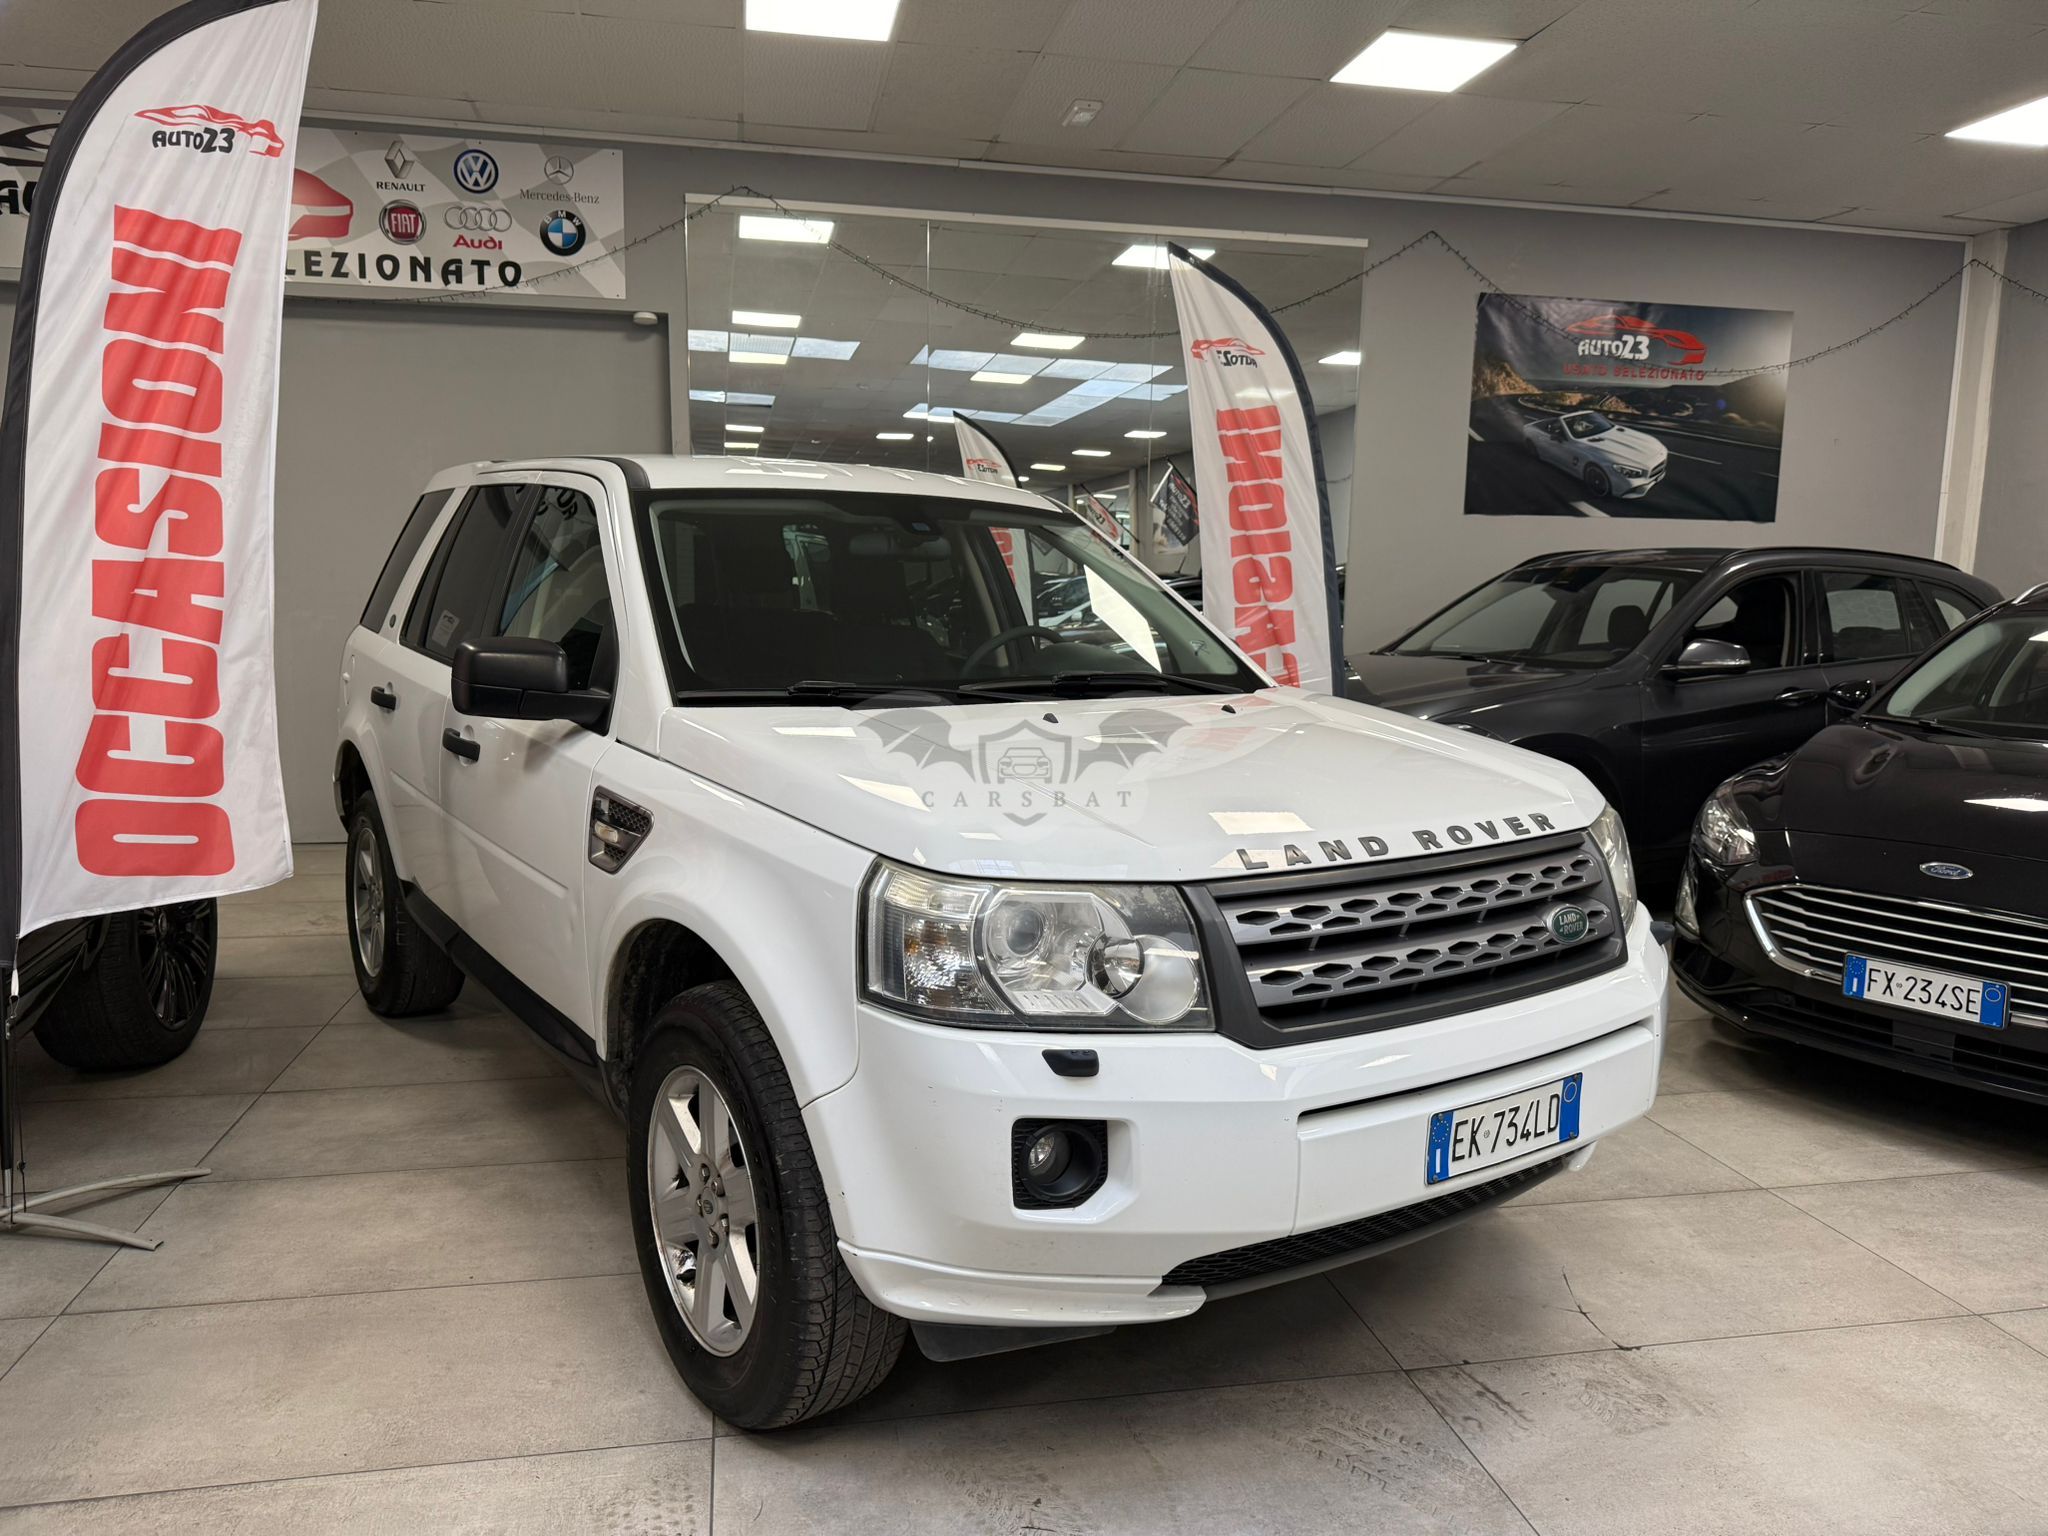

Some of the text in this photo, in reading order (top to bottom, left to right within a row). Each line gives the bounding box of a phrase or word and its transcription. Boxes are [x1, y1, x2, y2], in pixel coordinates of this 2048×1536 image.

[152, 126, 236, 154] AUTO23
[376, 181, 426, 193] RENAULT
[519, 188, 600, 205] Mercedes-Benz
[391, 213, 417, 233] FIAT
[544, 209, 582, 226] BMW
[452, 234, 503, 251] Audi
[285, 250, 522, 288] LEZIONATO
[1577, 333, 1650, 361] AUTO23
[75, 204, 243, 877] OCCASION
[1236, 811, 1556, 871] LAND ROVER
[1929, 865, 1961, 877] Ford
[1559, 913, 1577, 926] LAND
[1563, 921, 1584, 935] ROVER
[1867, 967, 1896, 997] FX
[1903, 975, 1981, 1016] 234SE
[1452, 1115, 1486, 1162] EK
[1490, 1093, 1561, 1154] 734LD
